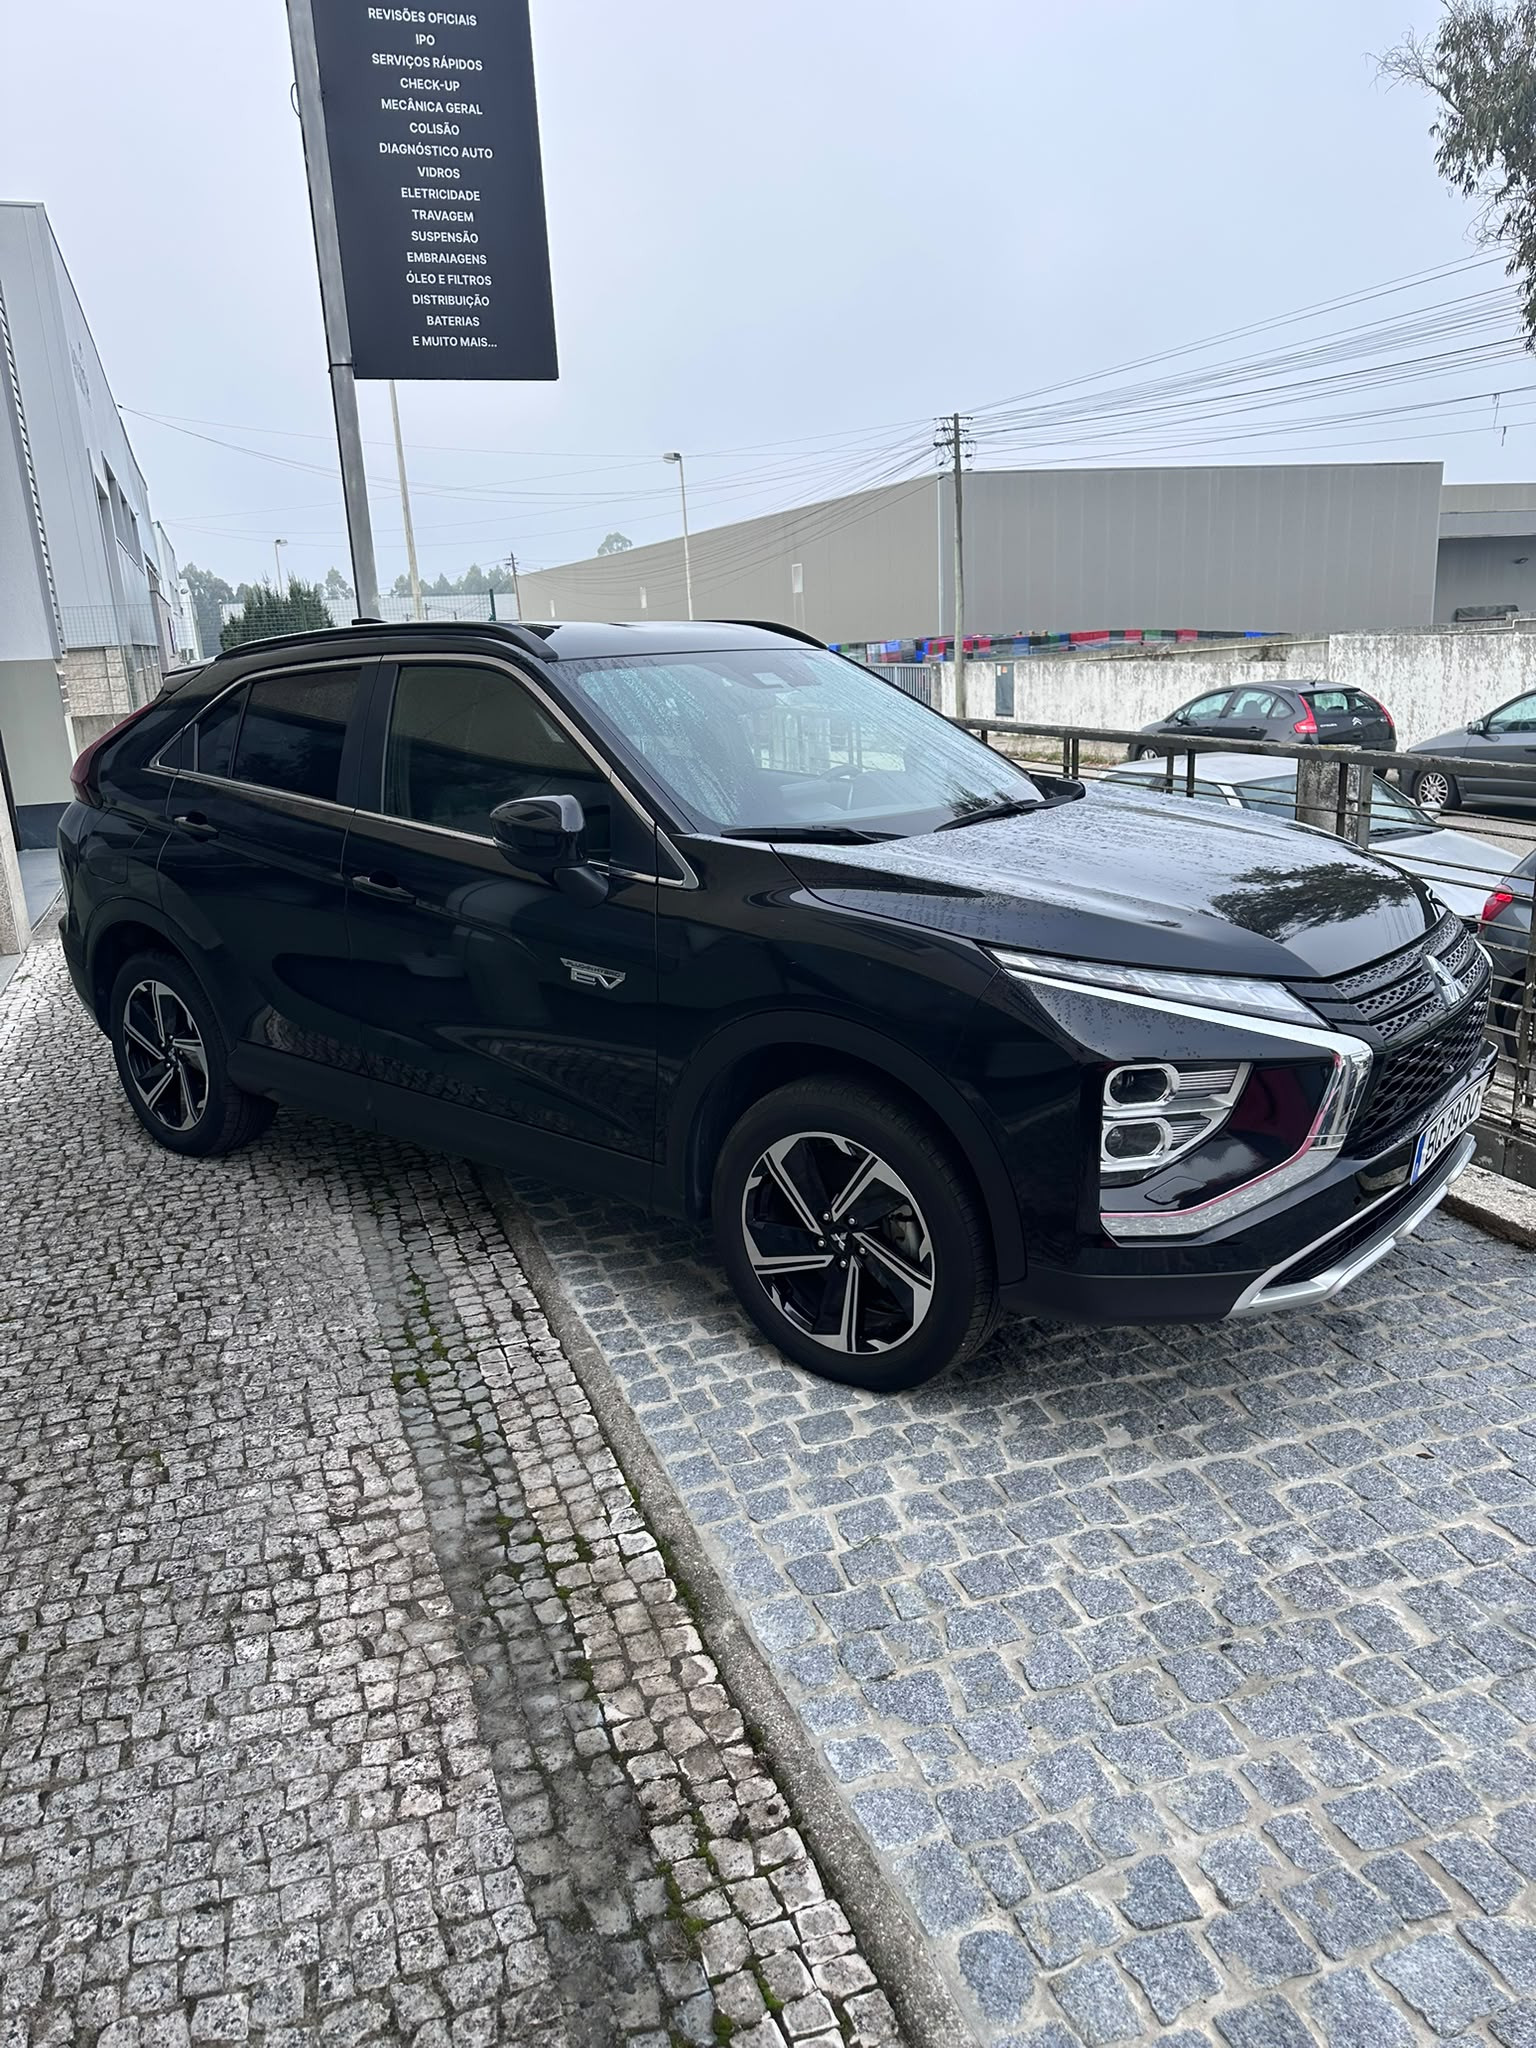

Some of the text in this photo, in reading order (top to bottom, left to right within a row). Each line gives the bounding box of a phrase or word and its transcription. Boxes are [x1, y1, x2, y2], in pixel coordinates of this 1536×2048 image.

[368, 7, 477, 26] REVISÕES OFICIAIS
[415, 34, 435, 46] IPO
[372, 53, 483, 71] SERVIÇOS RÁPIDOS
[400, 77, 460, 92] CHECK-UP
[381, 98, 483, 115] MECÂNICA GERAL
[409, 122, 460, 135] COLISÃO
[379, 142, 493, 159] DIAGNÓSTICO AUTO
[417, 166, 461, 179] VIDROS
[401, 187, 480, 201] ELETRICIDADE
[412, 209, 474, 222] TRAVAGEM
[411, 231, 478, 244] SUSPENSÃO
[407, 252, 487, 264] EMBRAIAGENS
[406, 270, 492, 286] ÓLEO E FILTROS
[412, 294, 489, 308] DISTRIBUIÇÃO
[426, 315, 480, 327] BATERIAS
[412, 336, 497, 348] E MUITO MAIS...
